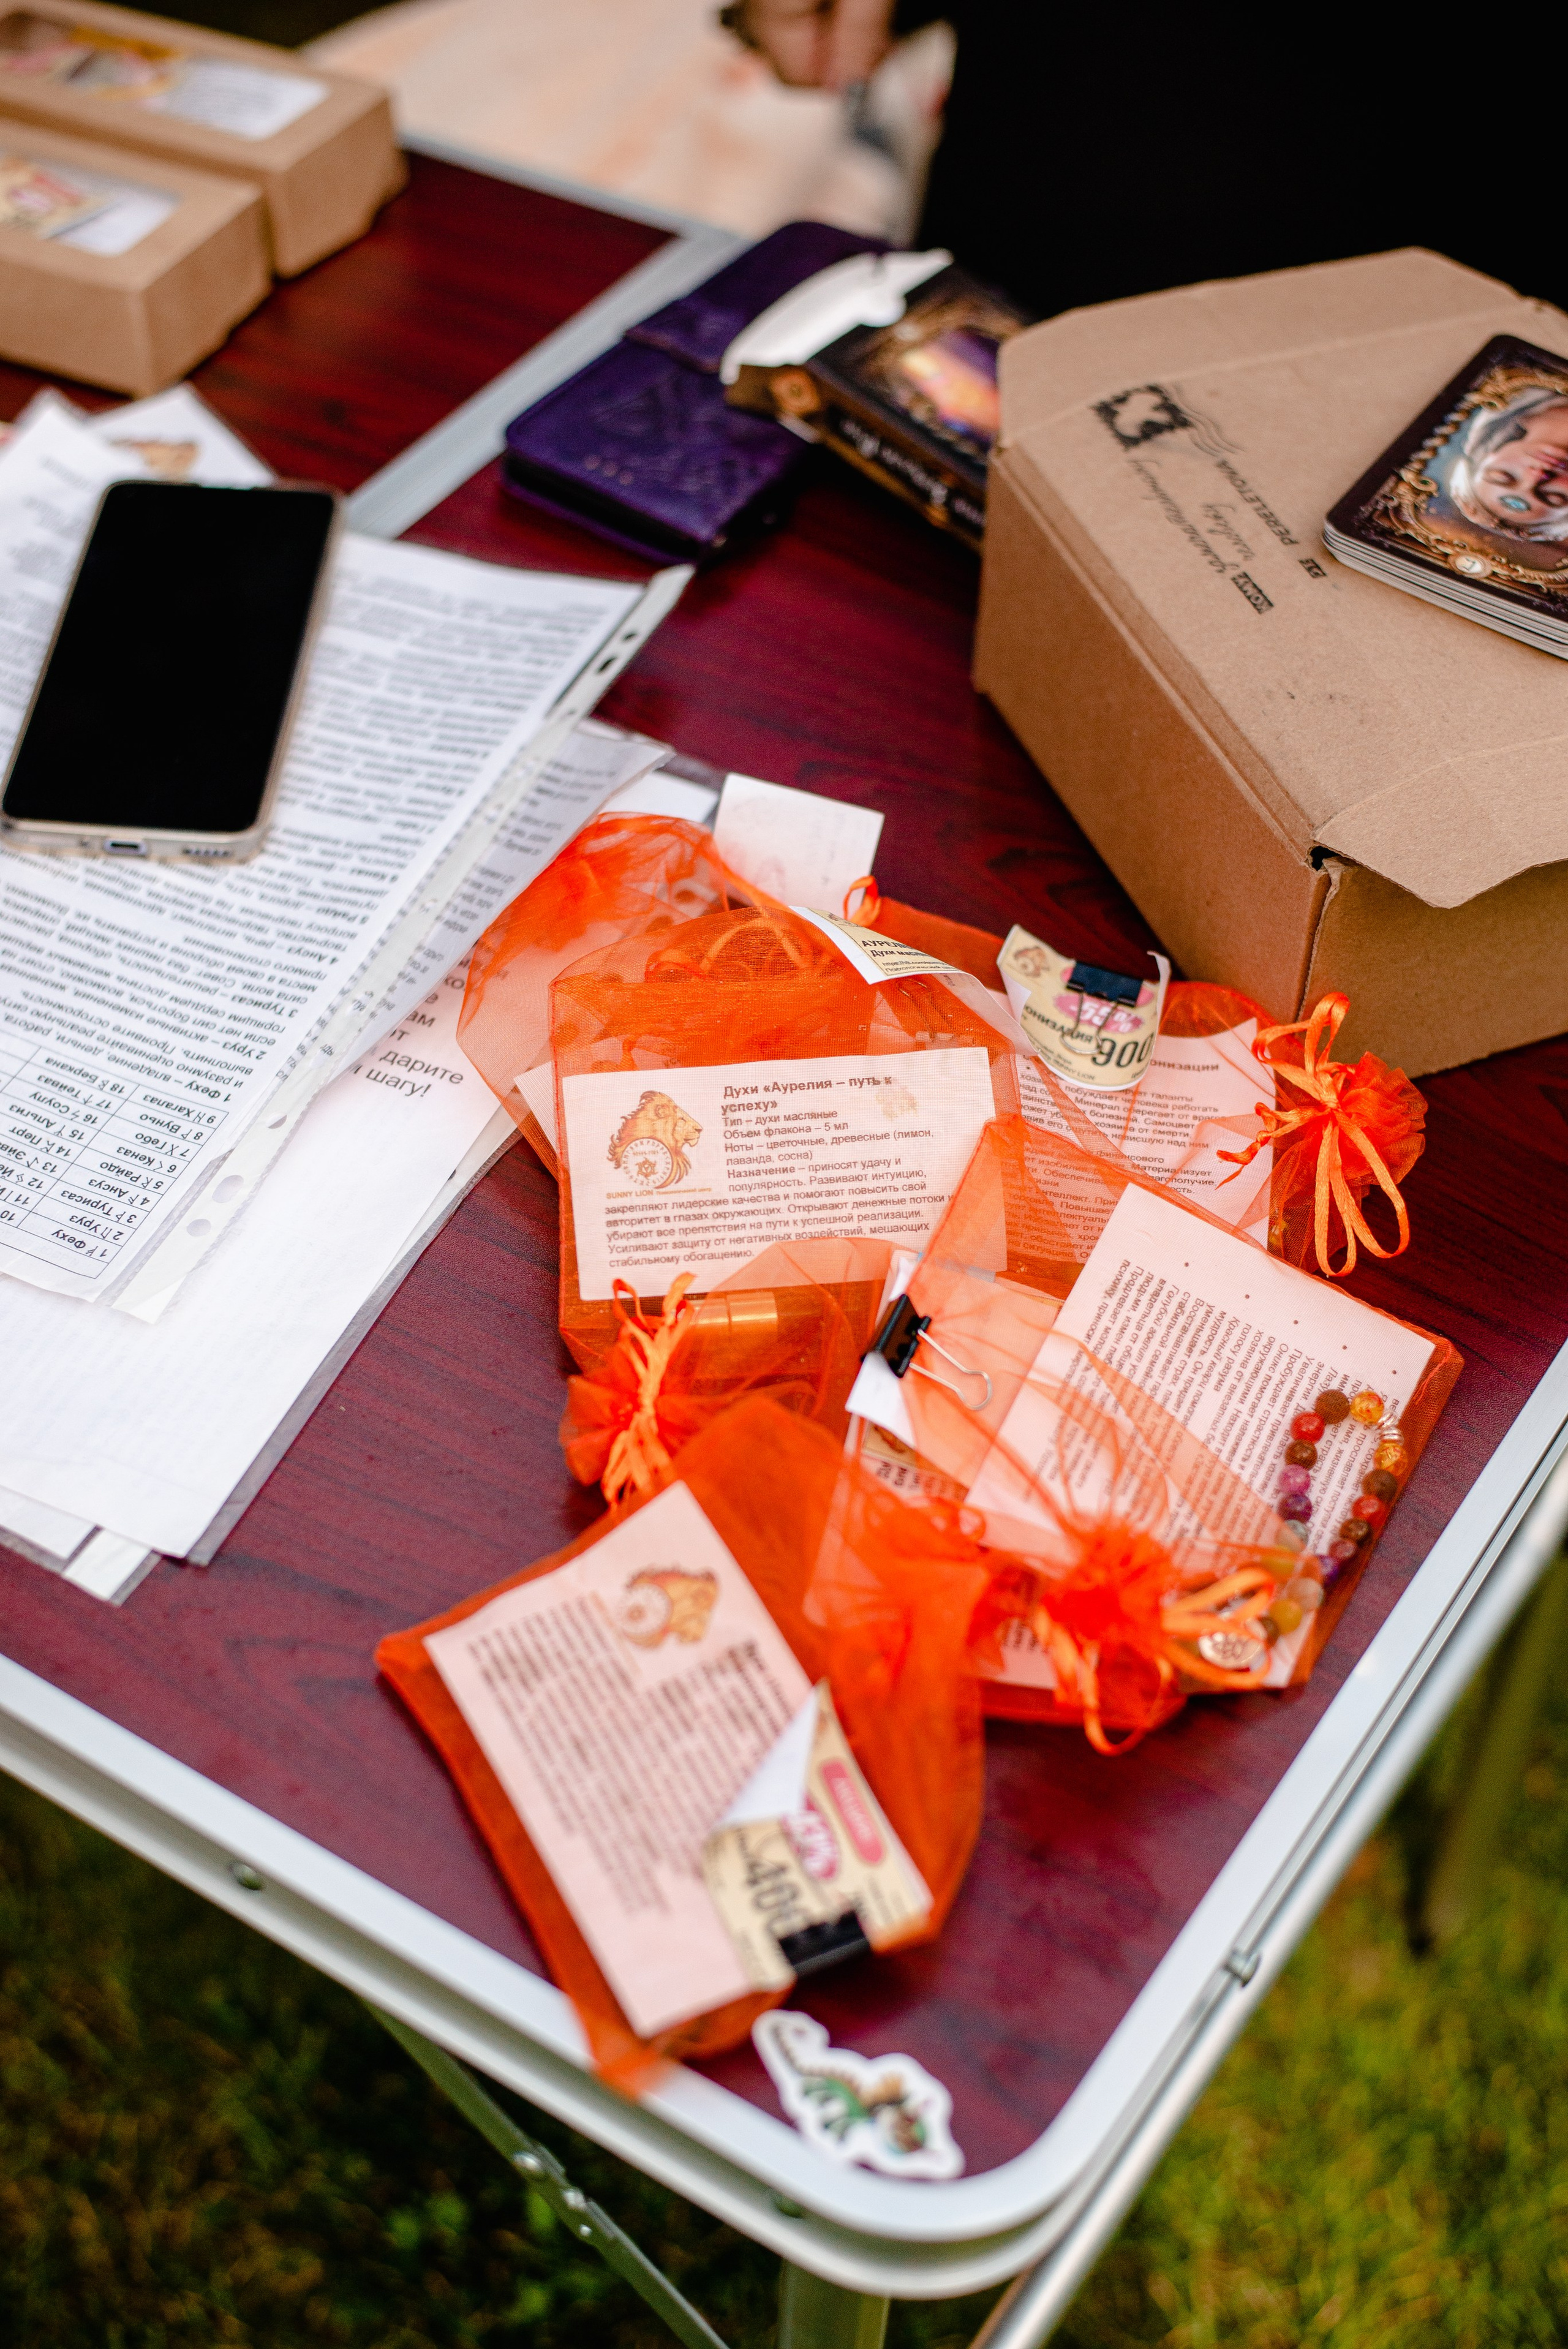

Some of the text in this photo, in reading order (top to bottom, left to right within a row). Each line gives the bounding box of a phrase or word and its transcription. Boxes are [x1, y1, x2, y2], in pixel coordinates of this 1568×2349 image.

[168, 995, 285, 1033] горящим сердцем
[231, 995, 284, 1015] Турисаз
[146, 1017, 266, 1060] 2 Уруз активные
[192, 1018, 276, 1046] если нет сил
[96, 1035, 174, 1066] оценивайте
[111, 1025, 254, 1075] выполнить. Проявите
[45, 1057, 124, 1093] 18 Беркана
[107, 1055, 172, 1082] владение,
[176, 1064, 233, 1085] разумно
[365, 1068, 431, 1097] шагу!
[378, 1050, 463, 1084] дарите
[37, 1075, 111, 1109] 17 Тейваз
[184, 1080, 221, 1098] Феху
[223, 1093, 230, 1102] 1
[723, 1085, 758, 1098] Духи
[763, 1080, 832, 1094] «Аурелия
[848, 1076, 881, 1088] путь
[1064, 1085, 1118, 1101] побуждает
[1151, 1092, 1193, 1101] таланты
[29, 1092, 97, 1124] 16 Соулу
[143, 1095, 195, 1117] Хагалаз
[721, 1100, 777, 1115] успеху»
[722, 1110, 837, 1126] Тип духи масляные
[1074, 1096, 1120, 1111] Минерал
[9, 1104, 84, 1140] 15 Альгиз
[139, 1114, 203, 1140] 8 Вуньо
[723, 1129, 761, 1139] Объем
[764, 1125, 812, 1137] флакона
[824, 1122, 830, 1131] 5
[1144, 1118, 1194, 1128] Самоцвет
[9, 1126, 70, 1156] 14 Перт
[135, 1133, 189, 1157] 7 Гебо
[725, 1143, 753, 1152] Ноты
[831, 1132, 890, 1145] древесные
[893, 1129, 933, 1141] (лимон,
[777, 1150, 813, 1161] сосна)
[42, 1161, 57, 1173] 13
[99, 1161, 164, 1189] 5 Райдо
[116, 1146, 176, 1173] 6 Кеназ
[727, 1166, 795, 1178] Назначение
[808, 1161, 858, 1174] приносят
[861, 1159, 891, 1170] удачу
[27, 1177, 43, 1189] 12
[88, 1178, 150, 1205] 4 Ансуз
[728, 1169, 926, 1192] популярность. Развивают интуицию,
[14, 1193, 29, 1205] 11
[60, 1190, 137, 1223] 3 Турисаз
[605, 1202, 668, 1215] закрепляют
[671, 1198, 729, 1209] лидерские
[732, 1194, 780, 1204] качества
[793, 1188, 845, 1199] помогают
[848, 1185, 899, 1195] повысить
[902, 1181, 926, 1191] свой
[606, 1216, 660, 1227] авторитет
[673, 1213, 709, 1221] глазах
[711, 1207, 781, 1220] окружающих.
[787, 1201, 848, 1214] Открывают
[851, 1197, 906, 1210] денежные
[909, 1194, 944, 1204] потоки
[0, 1210, 15, 1221] 10
[69, 1215, 124, 1240] 2 Уруз
[606, 1229, 654, 1243] убирают
[657, 1228, 675, 1237] все
[679, 1223, 746, 1237] препятствия
[765, 1220, 789, 1230] пути
[801, 1213, 854, 1227] успешной
[857, 1210, 924, 1223] реализации.
[51, 1229, 107, 1257] 1 Феху
[608, 1242, 668, 1254] Усиливают
[671, 1239, 710, 1249] защиту
[714, 1237, 725, 1246] от
[729, 1232, 792, 1244] негативных
[869, 1223, 929, 1234] мешающих
[609, 1250, 752, 1267] стабильному обогащению.
[1103, 1259, 1131, 1299] психику,
[1109, 1265, 1144, 1325] Продлевает
[1114, 1269, 1154, 1344] людьми, измен
[1153, 1284, 1180, 1326] Голубой
[1129, 1278, 1166, 1344] владельца от
[1159, 1291, 1190, 1348] стабильной
[1159, 1297, 1205, 1380] Восстанавливает
[1169, 1303, 1215, 1386] уменьшает страх,
[1197, 1316, 1240, 1389] Красный кварц
[1173, 1310, 1226, 1412] мудрость. Он придает
[1213, 1322, 1252, 1392] голосу разума
[1210, 1329, 1264, 1432] хозяина от внезапных
[1219, 1336, 1275, 1446] окружающими. Находит
[1247, 1343, 1289, 1418] Оникс помогает
[1278, 1355, 1315, 1419] Увеличивает
[1301, 1361, 1324, 1400] энергии.
[1241, 1348, 1303, 1462] Пробуждает страстность
[1311, 1439, 1333, 1473] страсть
[1319, 1422, 1356, 1495] имя, жизненную
[1340, 1432, 1367, 1490] прославляет
